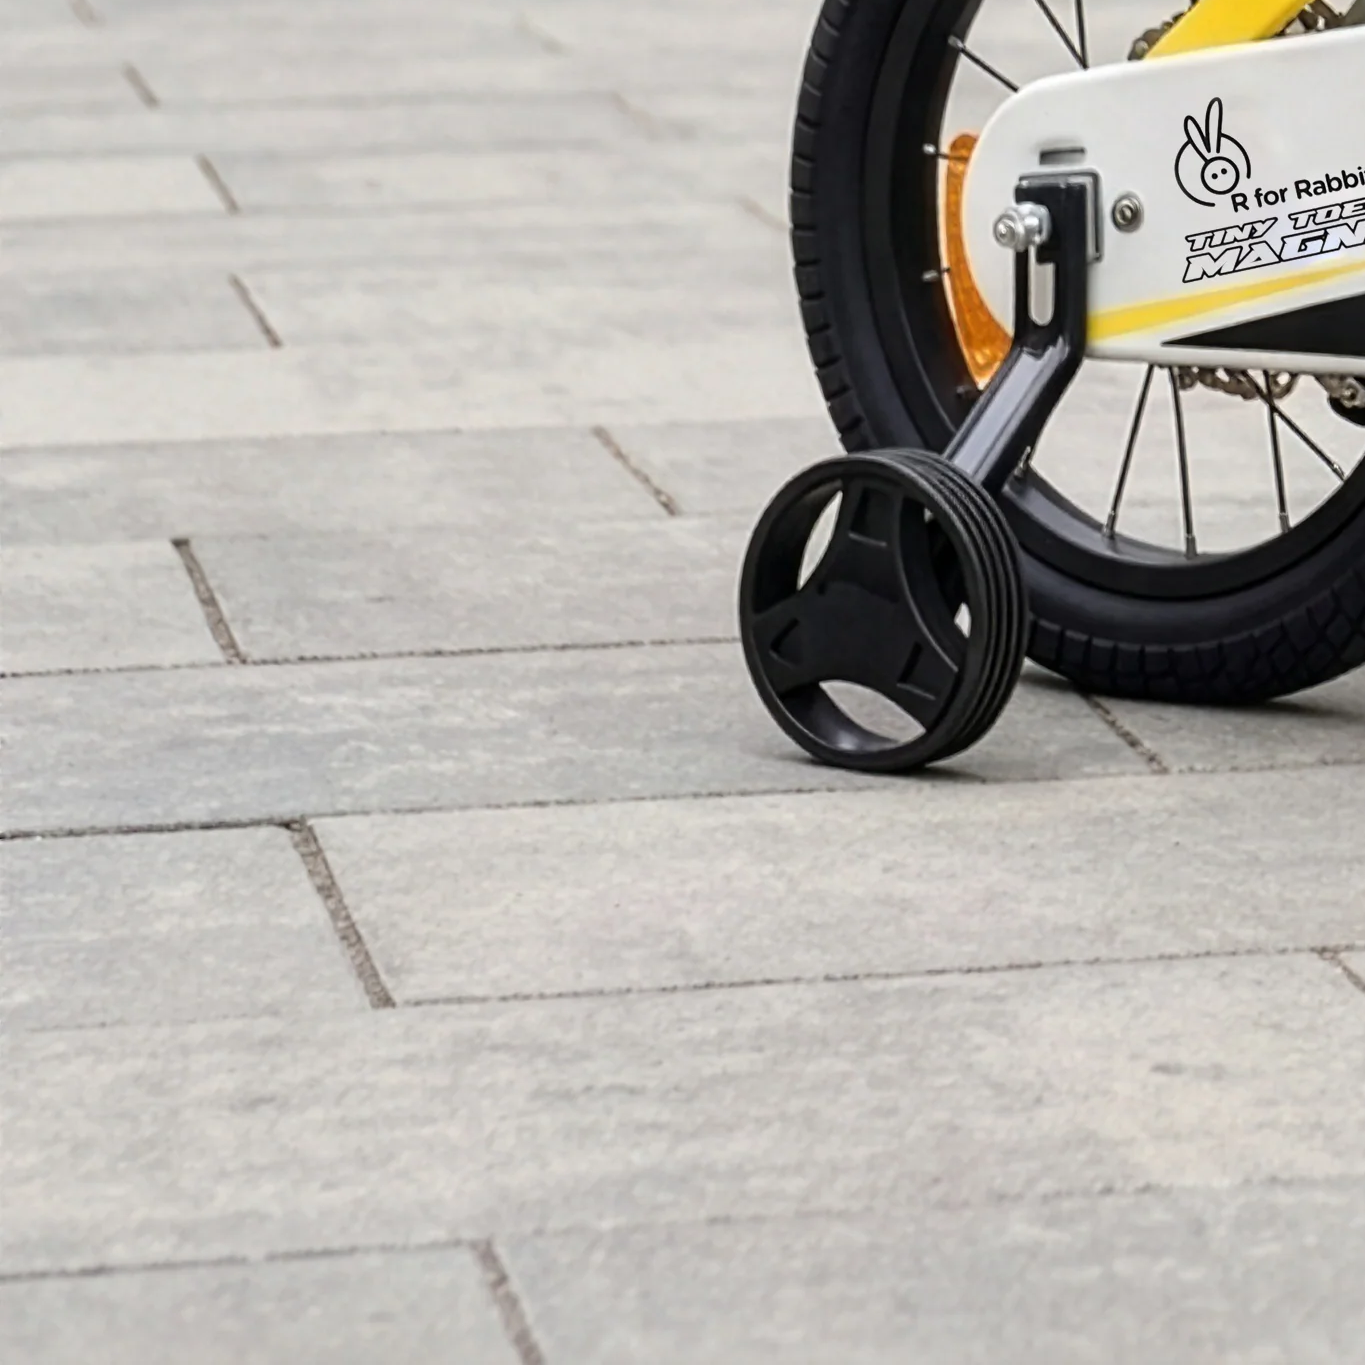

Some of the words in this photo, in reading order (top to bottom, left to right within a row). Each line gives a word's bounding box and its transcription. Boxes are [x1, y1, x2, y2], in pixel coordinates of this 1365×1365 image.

[1231, 193, 1250, 213] R
[1254, 185, 1288, 208] for
[1185, 216, 1279, 252] TINY
